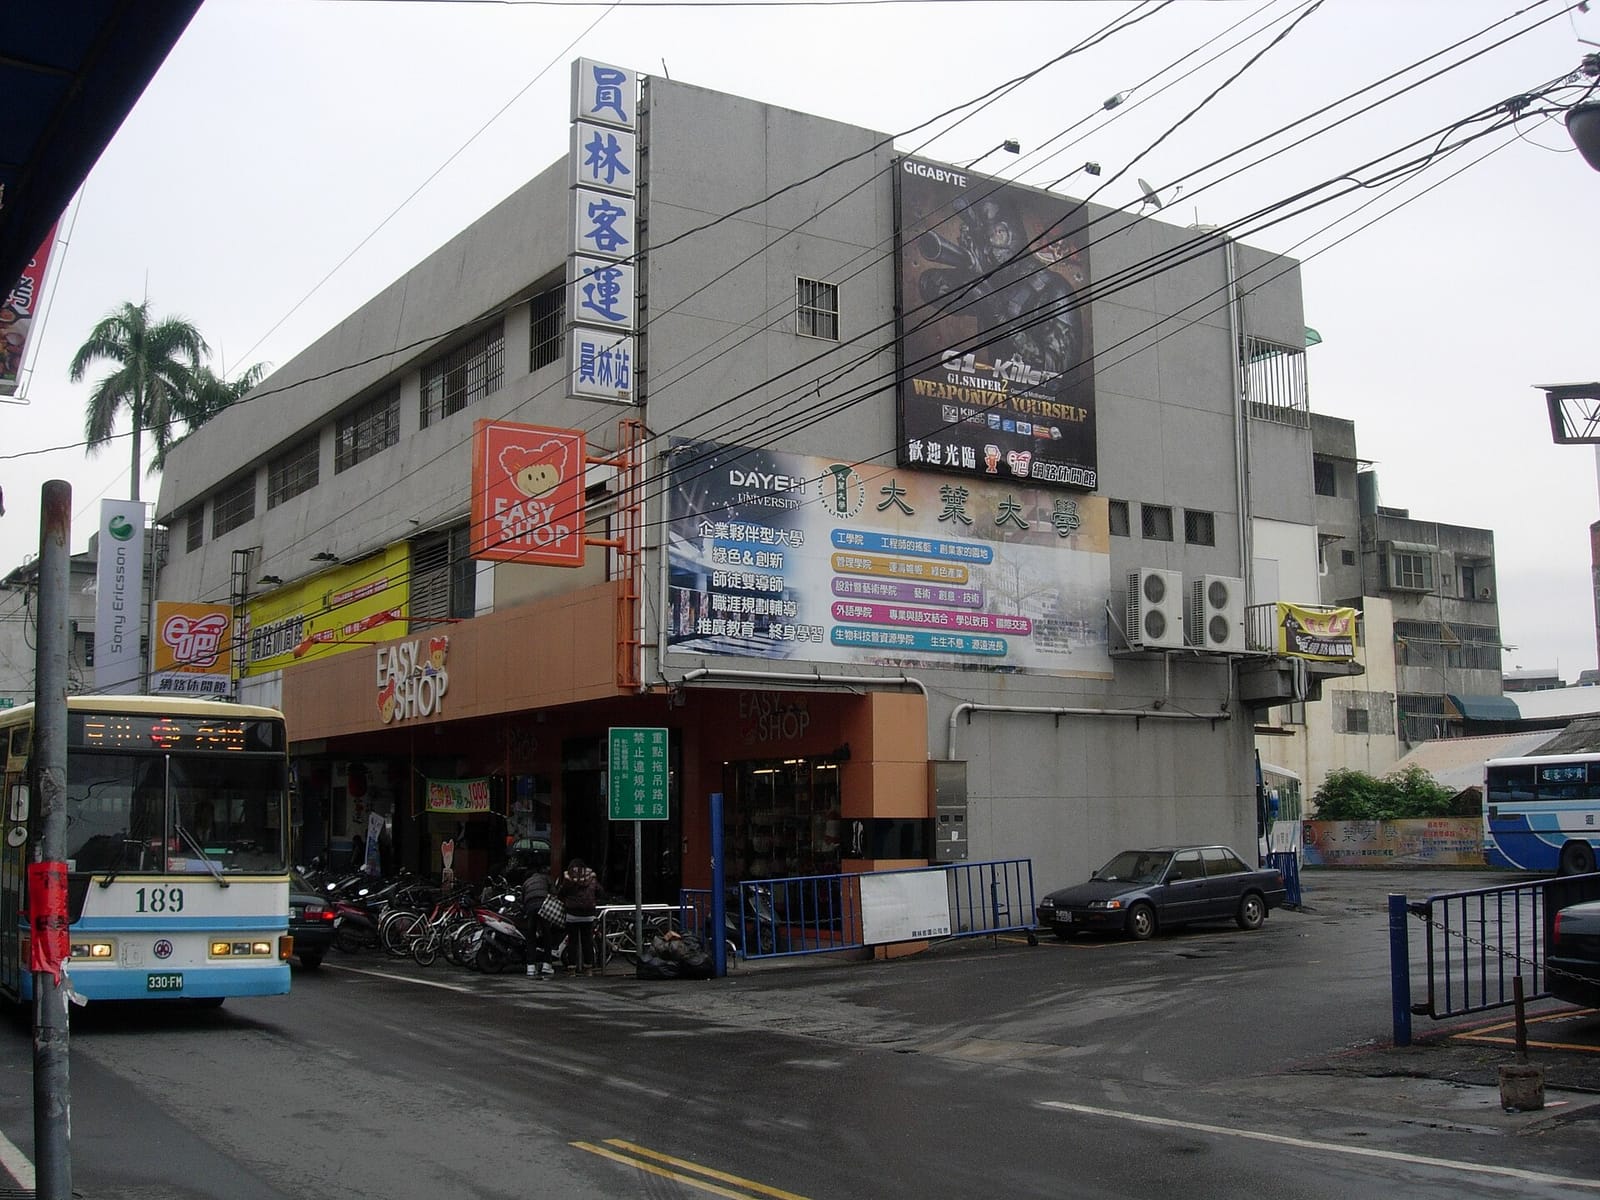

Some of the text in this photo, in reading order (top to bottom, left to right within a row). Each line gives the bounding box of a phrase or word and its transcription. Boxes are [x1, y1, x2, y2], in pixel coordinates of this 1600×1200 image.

[903, 161, 967, 188] GIGABYTE
[582, 65, 631, 322] 員林客運
[579, 341, 631, 389] 員林站
[912, 378, 1087, 422] WEAPONIZE YOURSELF
[908, 438, 976, 469] 歡迎光臨
[729, 470, 806, 495] DAYEH
[494, 497, 556, 526] EASY
[737, 492, 803, 511] UNIVERSITY
[876, 478, 1081, 538] 大葉大學
[500, 515, 570, 548] SHOP
[698, 520, 805, 548] 企業夥伴型大學
[837, 532, 865, 546] 工學院
[712, 570, 784, 593] 師徒雙導師
[111, 547, 126, 653] Sony Ericsson
[712, 594, 797, 617] 職涯規劃輔導
[836, 605, 872, 618] 外語學院
[696, 618, 825, 643] 推廣教育 終身學習
[835, 629, 915, 646] 生物科技暨資源學院
[376, 640, 419, 687] EASY
[395, 672, 448, 720] SHOP
[759, 711, 810, 742] SHOP
[633, 732, 645, 815] 禁止違規停車
[652, 732, 664, 815] 重點拖吊路段
[136, 888, 184, 913] 189
[148, 976, 183, 989] 330-FM
